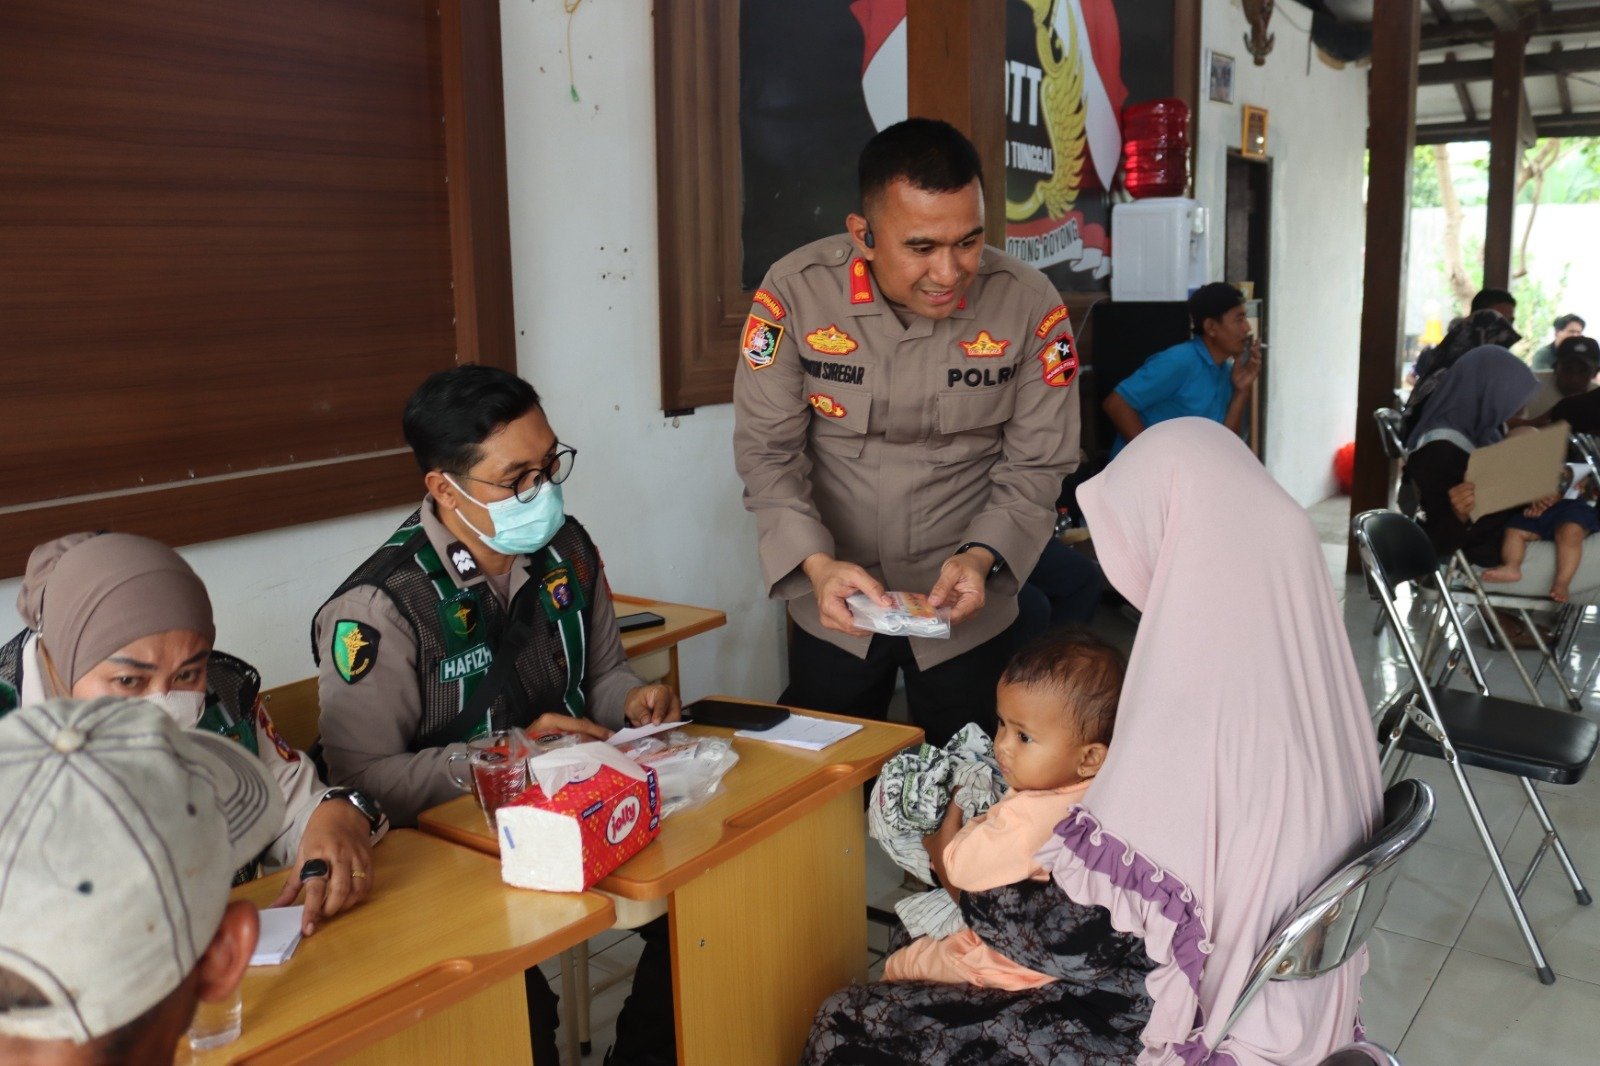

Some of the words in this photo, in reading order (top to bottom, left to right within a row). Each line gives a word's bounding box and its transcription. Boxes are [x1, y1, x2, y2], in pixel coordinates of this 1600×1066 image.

[1011, 141, 1054, 175] TUNGGAL
[1008, 237, 1040, 262] OTONG
[1042, 218, 1079, 258] ROYONG
[822, 361, 865, 386] SIREGAR
[947, 363, 1018, 388] POLRI
[444, 646, 493, 680] HAFIZH
[611, 802, 636, 841] jolly
